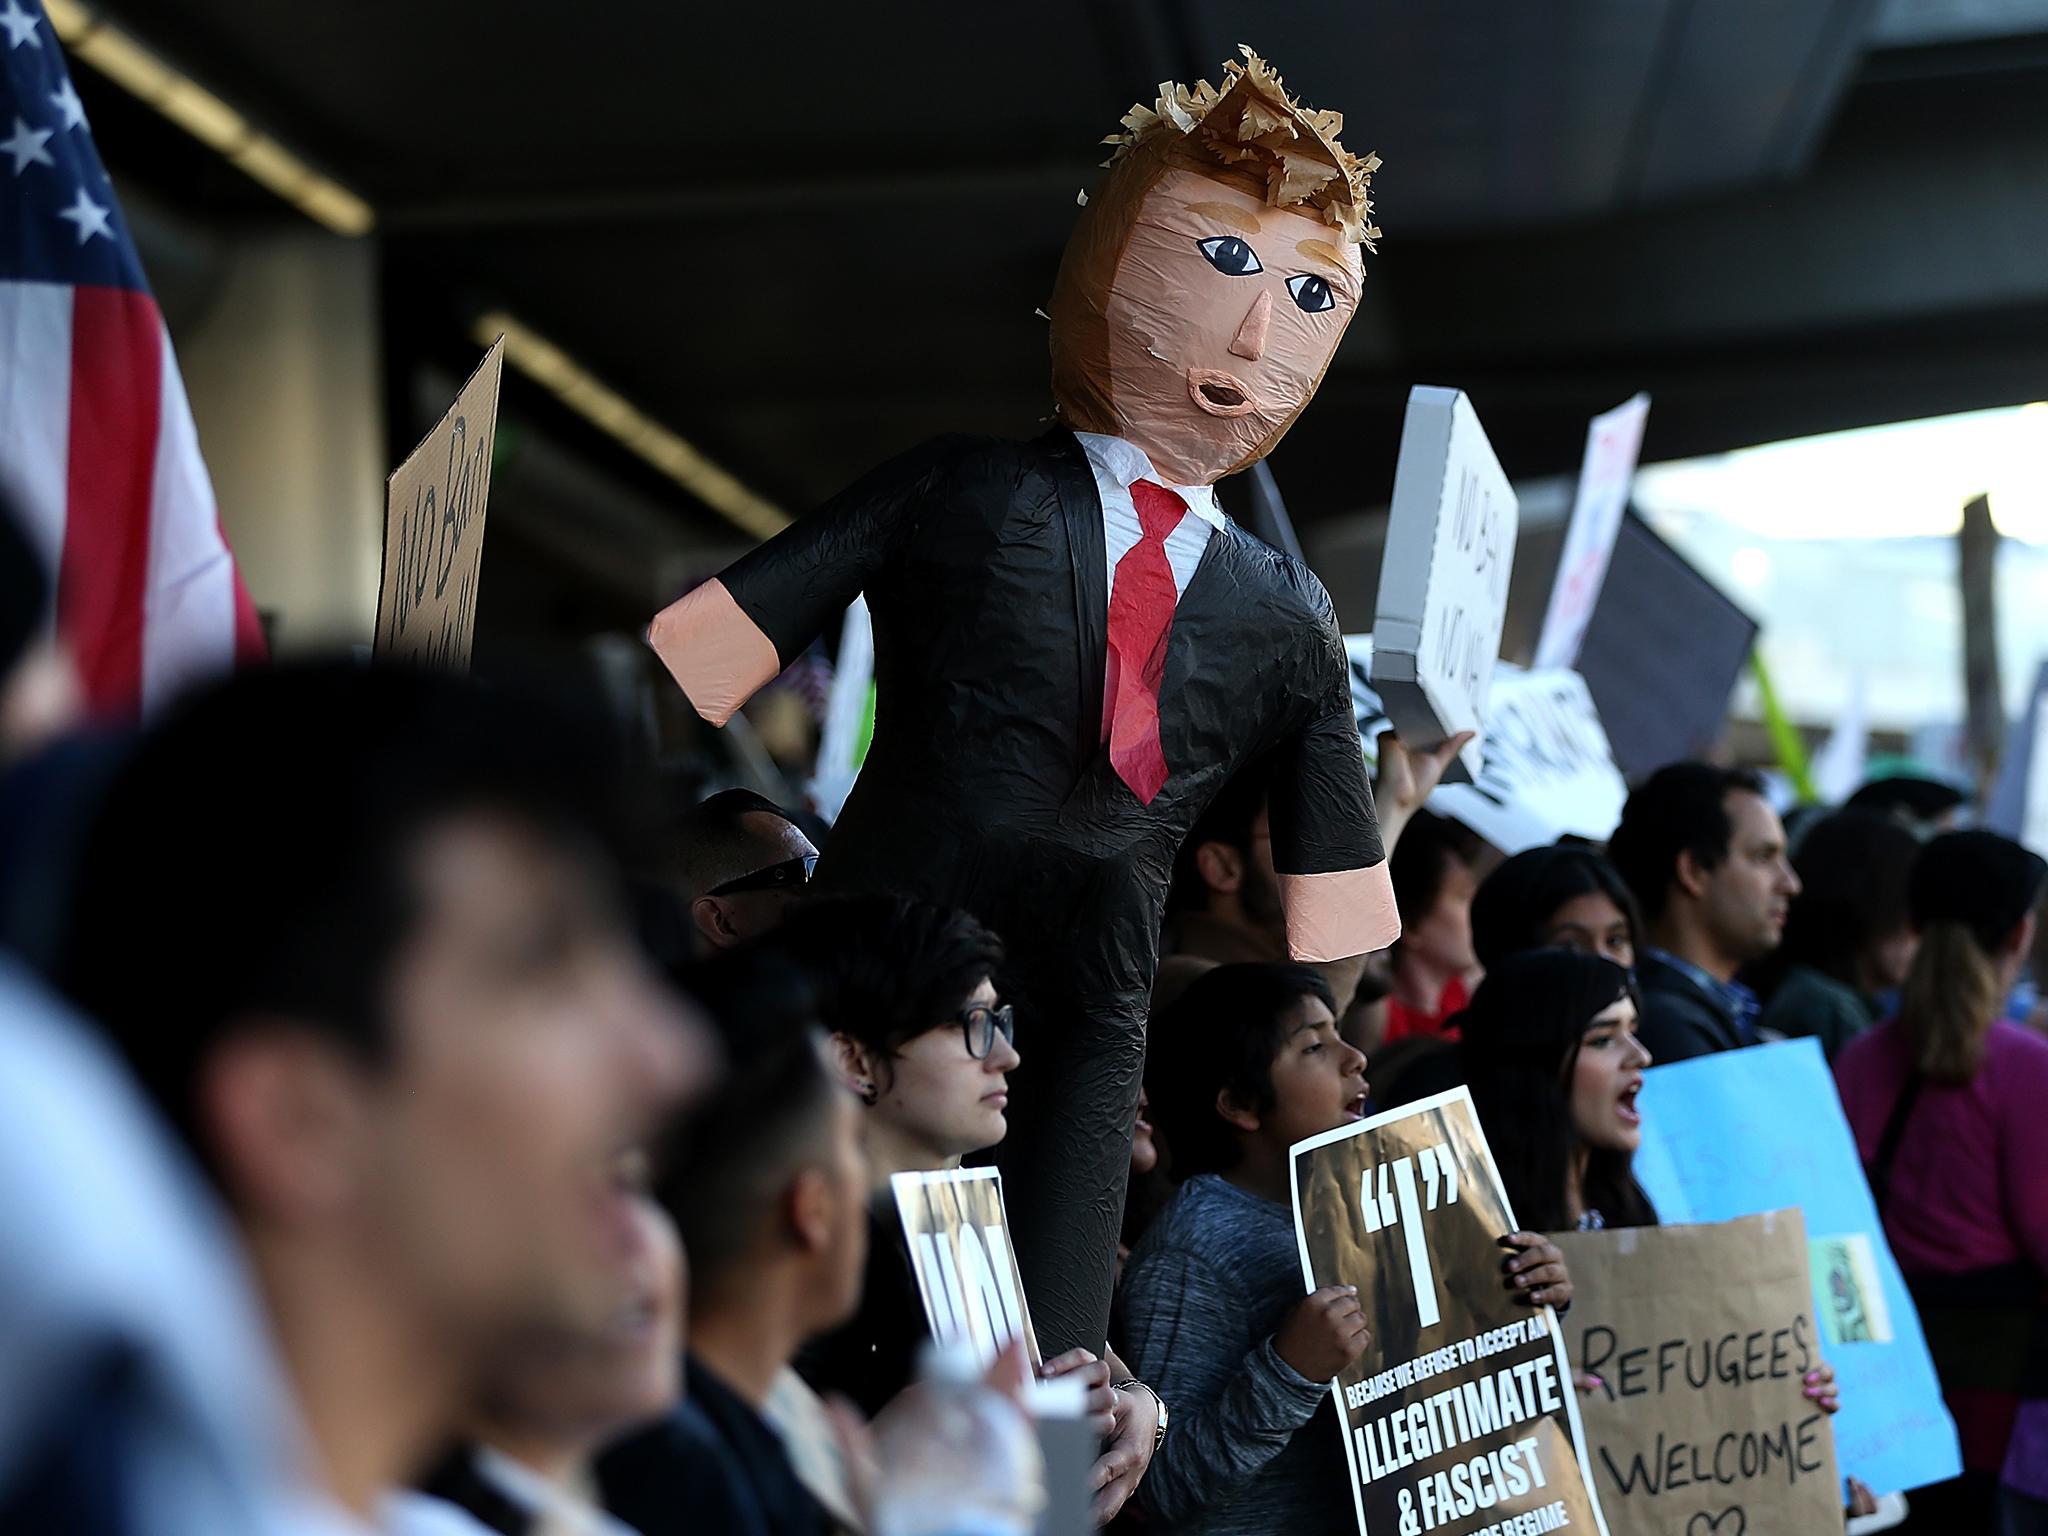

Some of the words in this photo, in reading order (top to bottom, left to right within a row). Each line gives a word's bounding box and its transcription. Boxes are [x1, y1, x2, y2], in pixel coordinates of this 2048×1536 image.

[390, 484, 436, 648] NO
[1345, 1368, 1397, 1410] BECAUSE
[1395, 1361, 1416, 1390] WE
[1412, 1345, 1460, 1382] REFUSE
[1457, 1338, 1477, 1365] TO
[1475, 1320, 1528, 1359] ACCEPT
[1526, 1313, 1550, 1342] AN
[1580, 1313, 1811, 1402] REFUGEES
[1353, 1354, 1562, 1486] ILLEGITIMATE
[1598, 1412, 1823, 1497] WELCOME
[1396, 1487, 1422, 1536] &
[1416, 1436, 1546, 1531] FASCIST
